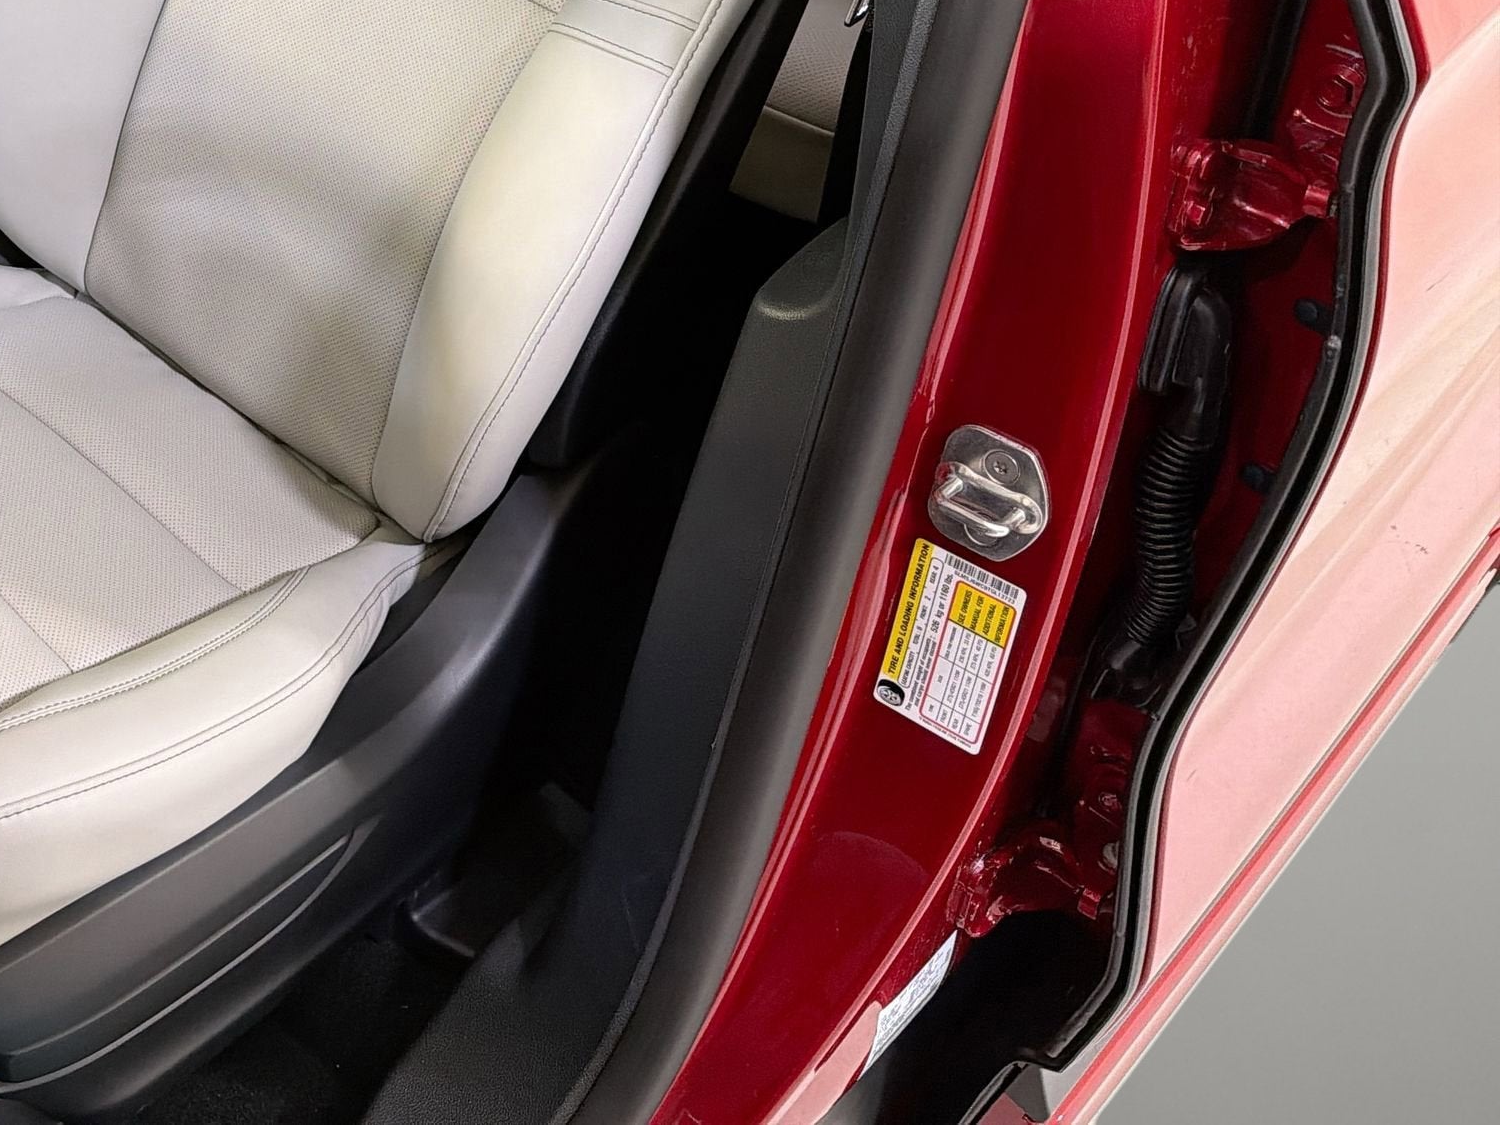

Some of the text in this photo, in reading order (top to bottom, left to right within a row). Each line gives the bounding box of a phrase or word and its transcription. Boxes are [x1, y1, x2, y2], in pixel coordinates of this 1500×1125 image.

[939, 584, 950, 601] 1160
[888, 543, 929, 674] TIRE AND LOADING INFORMATION
[934, 609, 944, 619] kg
[938, 601, 945, 610] or
[969, 595, 984, 630] MANUAL FOR
[930, 619, 940, 633] 526
[957, 613, 966, 624] SEE
[982, 604, 996, 635] ADDITIONAL
[994, 606, 1009, 643] INFORMATION
